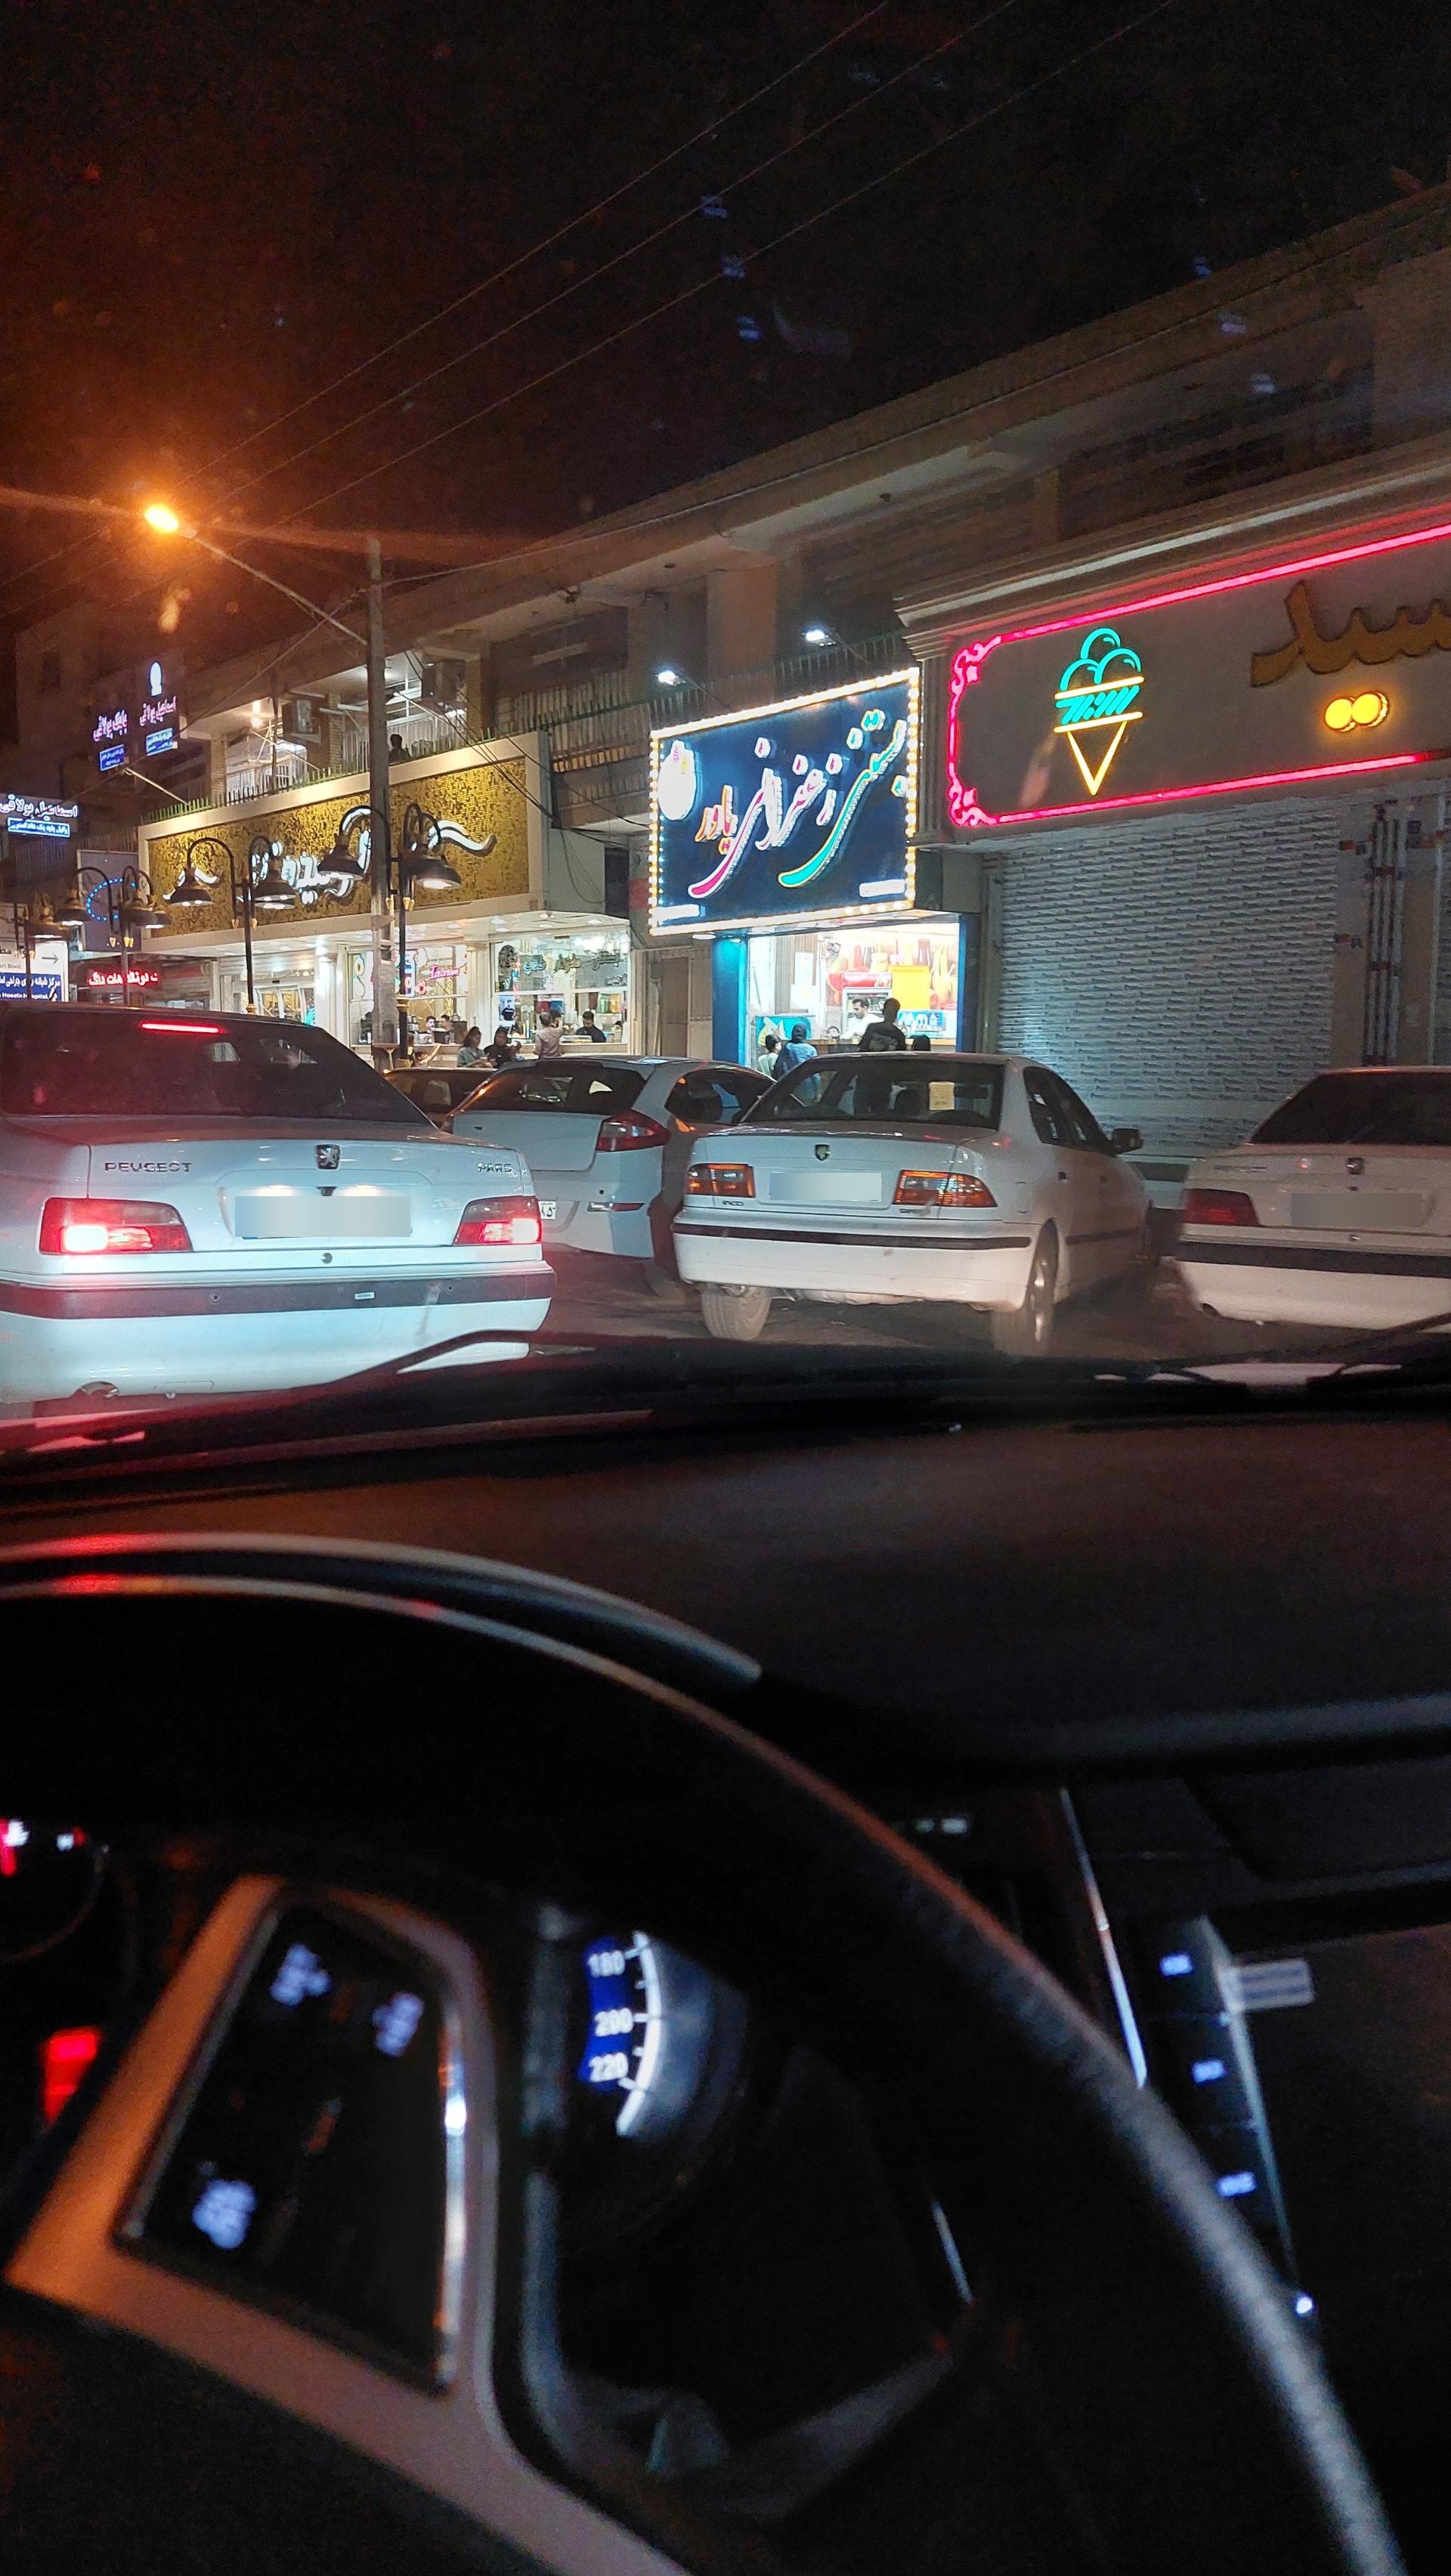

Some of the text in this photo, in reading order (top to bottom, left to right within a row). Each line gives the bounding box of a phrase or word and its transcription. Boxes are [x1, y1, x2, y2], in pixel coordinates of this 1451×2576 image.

[104, 1161, 192, 1173] PEUGEOT
[477, 1162, 512, 1173] PARS
[587, 1950, 626, 1978] 180
[593, 2007, 634, 2037] 200
[588, 2052, 630, 2083] 220
